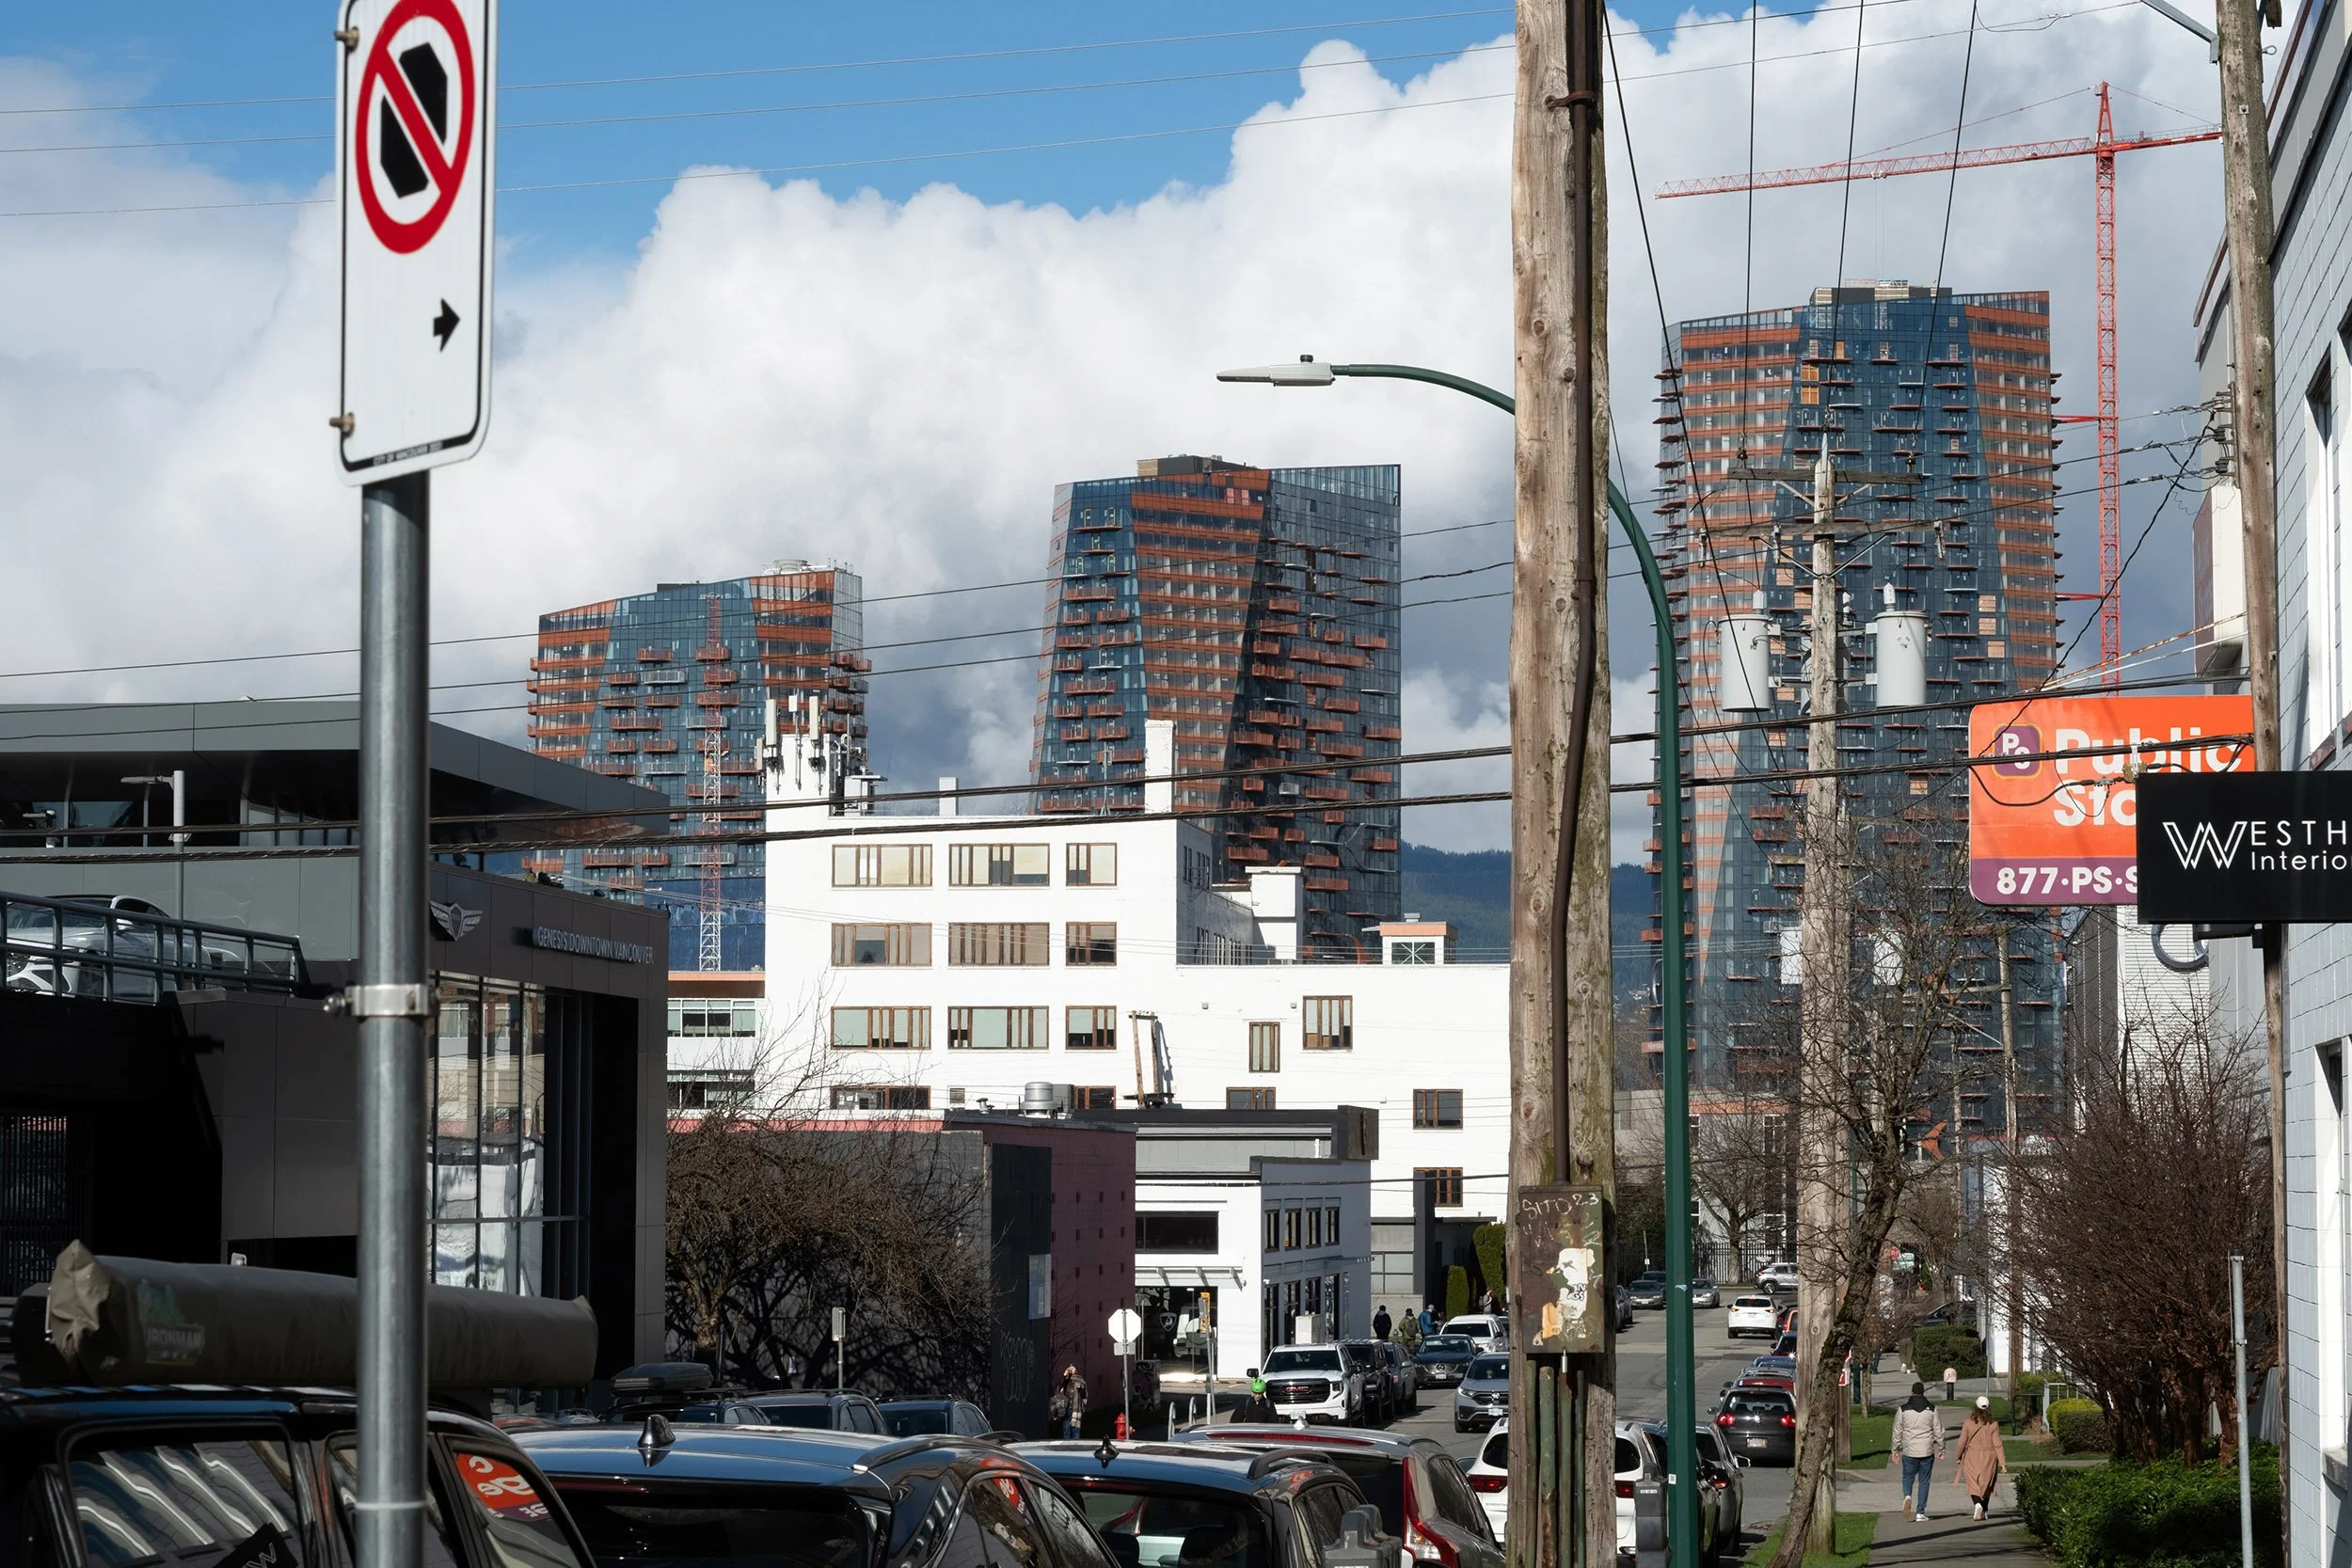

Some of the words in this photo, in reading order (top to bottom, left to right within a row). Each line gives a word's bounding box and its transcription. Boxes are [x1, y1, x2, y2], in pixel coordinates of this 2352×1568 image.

[2055, 726, 2242, 774] Public
[2162, 820, 2347, 870] WESTH
[2251, 850, 2352, 870] Interio
[537, 927, 568, 950] GENESIS
[569, 933, 613, 958] DOWNTOWN
[614, 941, 654, 965] VANCOUVER
